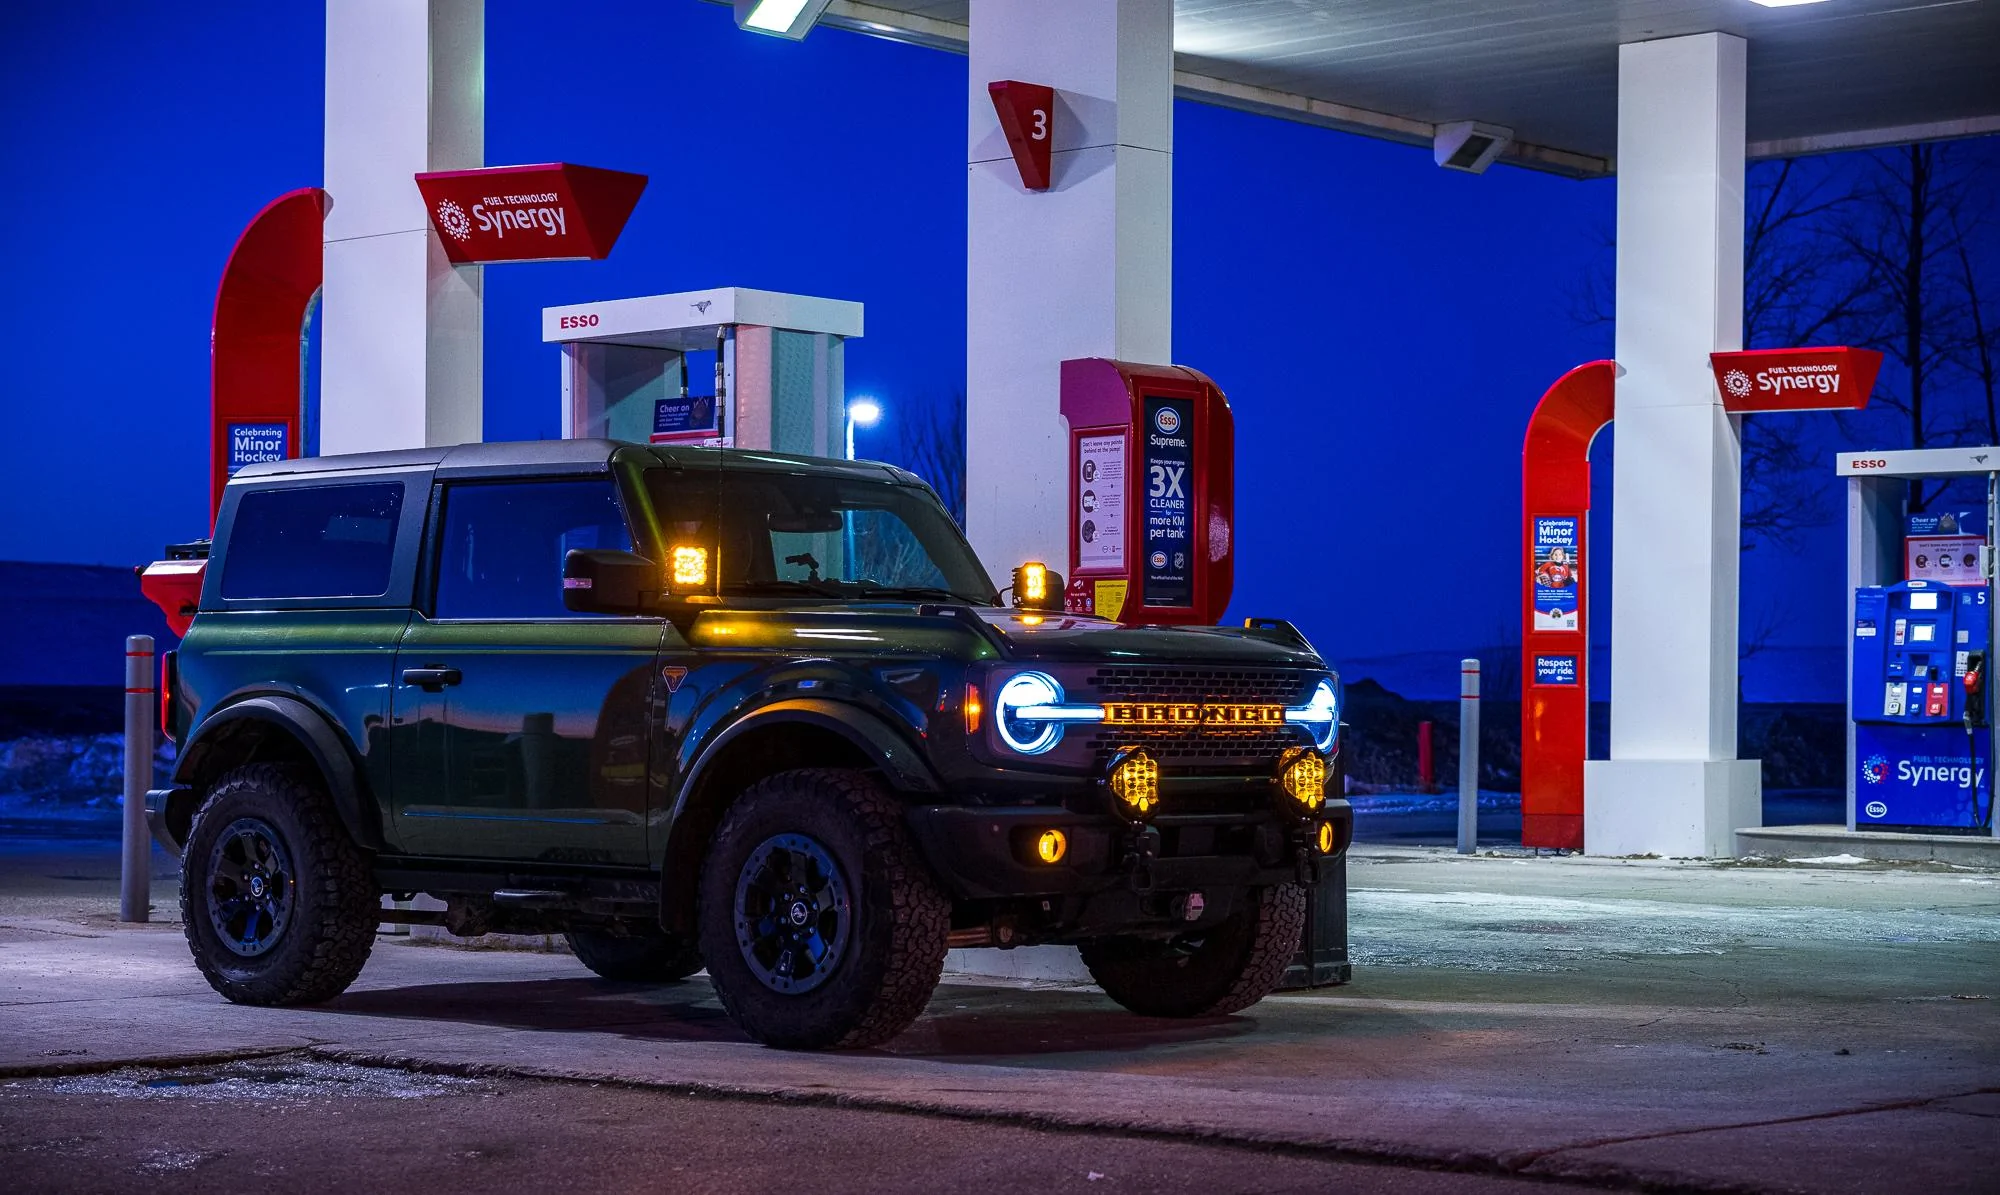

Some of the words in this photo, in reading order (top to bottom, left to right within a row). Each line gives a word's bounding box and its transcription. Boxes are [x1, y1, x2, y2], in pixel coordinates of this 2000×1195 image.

[1031, 109, 1047, 140] 3
[483, 196, 504, 206] FUEL
[504, 192, 559, 204] TECHNOLOGY
[472, 204, 567, 238] Synergy
[560, 314, 599, 329] ESSO
[1788, 364, 1837, 374] TECHNOLOGY
[1756, 372, 1840, 395] Synergy
[660, 404, 679, 413] Cheer
[680, 404, 690, 412] on
[234, 428, 282, 438] Celebrating
[234, 437, 281, 450] Minor
[1852, 460, 1886, 468] ESSO
[1150, 466, 1185, 498] 3X
[1150, 499, 1184, 509] CLEANER
[1150, 517, 1171, 526] more
[1173, 516, 1185, 526] KM
[1150, 529, 1165, 540] per
[1539, 526, 1573, 536] Minor
[1539, 535, 1573, 545] Hockey
[1977, 592, 1985, 605] 5
[1538, 658, 1572, 668] Respect
[1538, 668, 1556, 676] your
[1111, 705, 1284, 723] BRONCO
[1869, 805, 1884, 813] Esso
